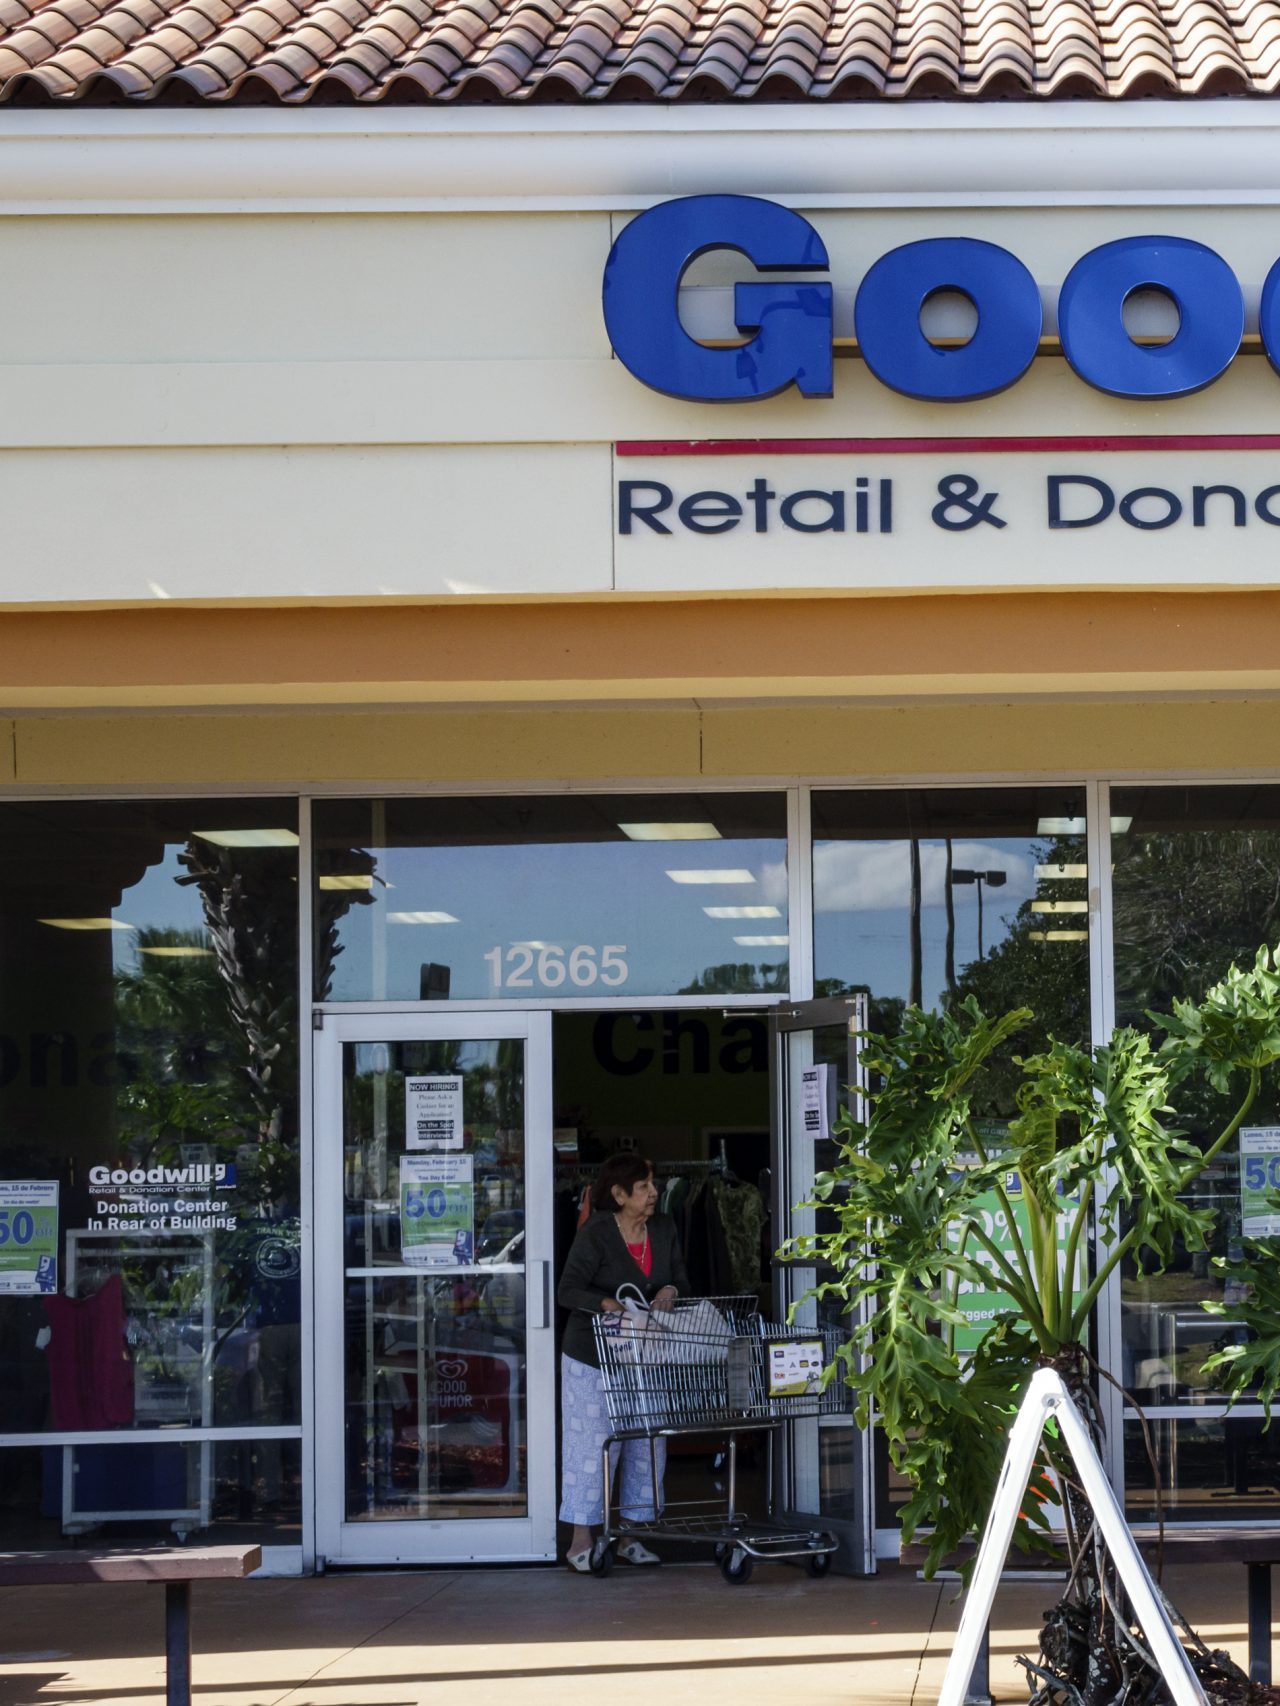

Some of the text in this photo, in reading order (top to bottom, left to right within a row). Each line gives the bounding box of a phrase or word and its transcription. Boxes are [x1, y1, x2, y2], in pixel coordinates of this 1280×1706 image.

[617, 477, 893, 535] Retail
[931, 473, 1008, 533] &
[484, 944, 629, 988] 12665
[410, 1083, 428, 1091] NOW
[439, 1121, 455, 1129] Spot
[88, 1163, 211, 1185] Goodwill
[129, 1186, 174, 1194] Donation
[176, 1185, 211, 1193] Center
[97, 1199, 228, 1214] Donation Center
[405, 1189, 447, 1218] 50
[88, 1215, 237, 1231] In Rear of Building
[439, 1394, 473, 1408] UMOR
